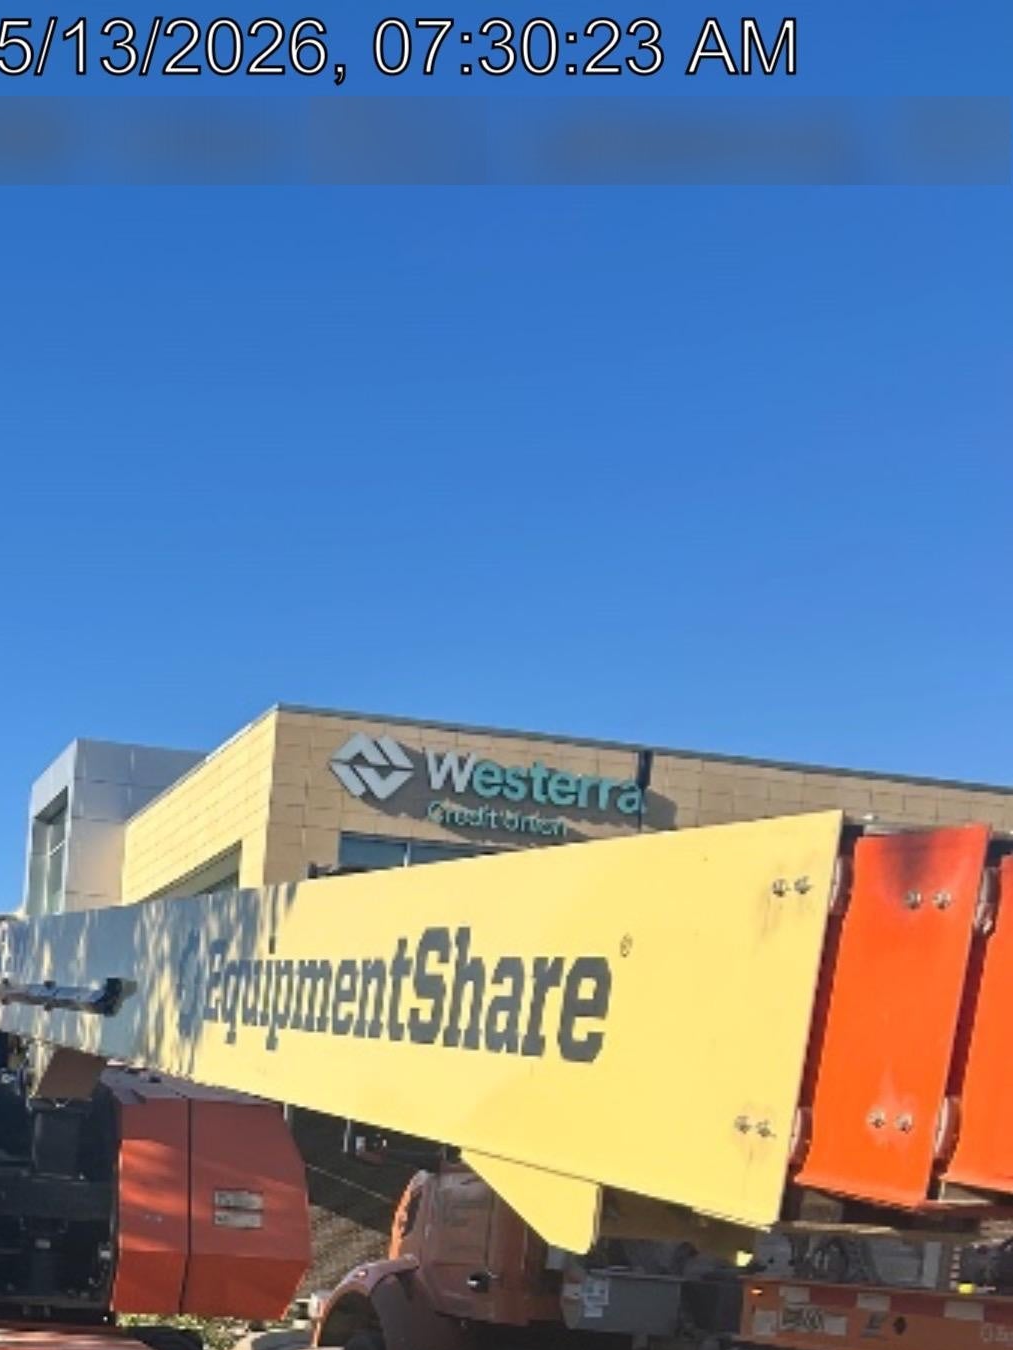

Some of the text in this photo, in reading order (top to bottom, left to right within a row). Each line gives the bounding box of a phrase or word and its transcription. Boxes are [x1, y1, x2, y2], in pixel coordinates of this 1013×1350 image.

[425, 749, 644, 814] Westerra
[427, 800, 568, 837] Credit Union
[204, 926, 613, 1064] EquipmentShare
